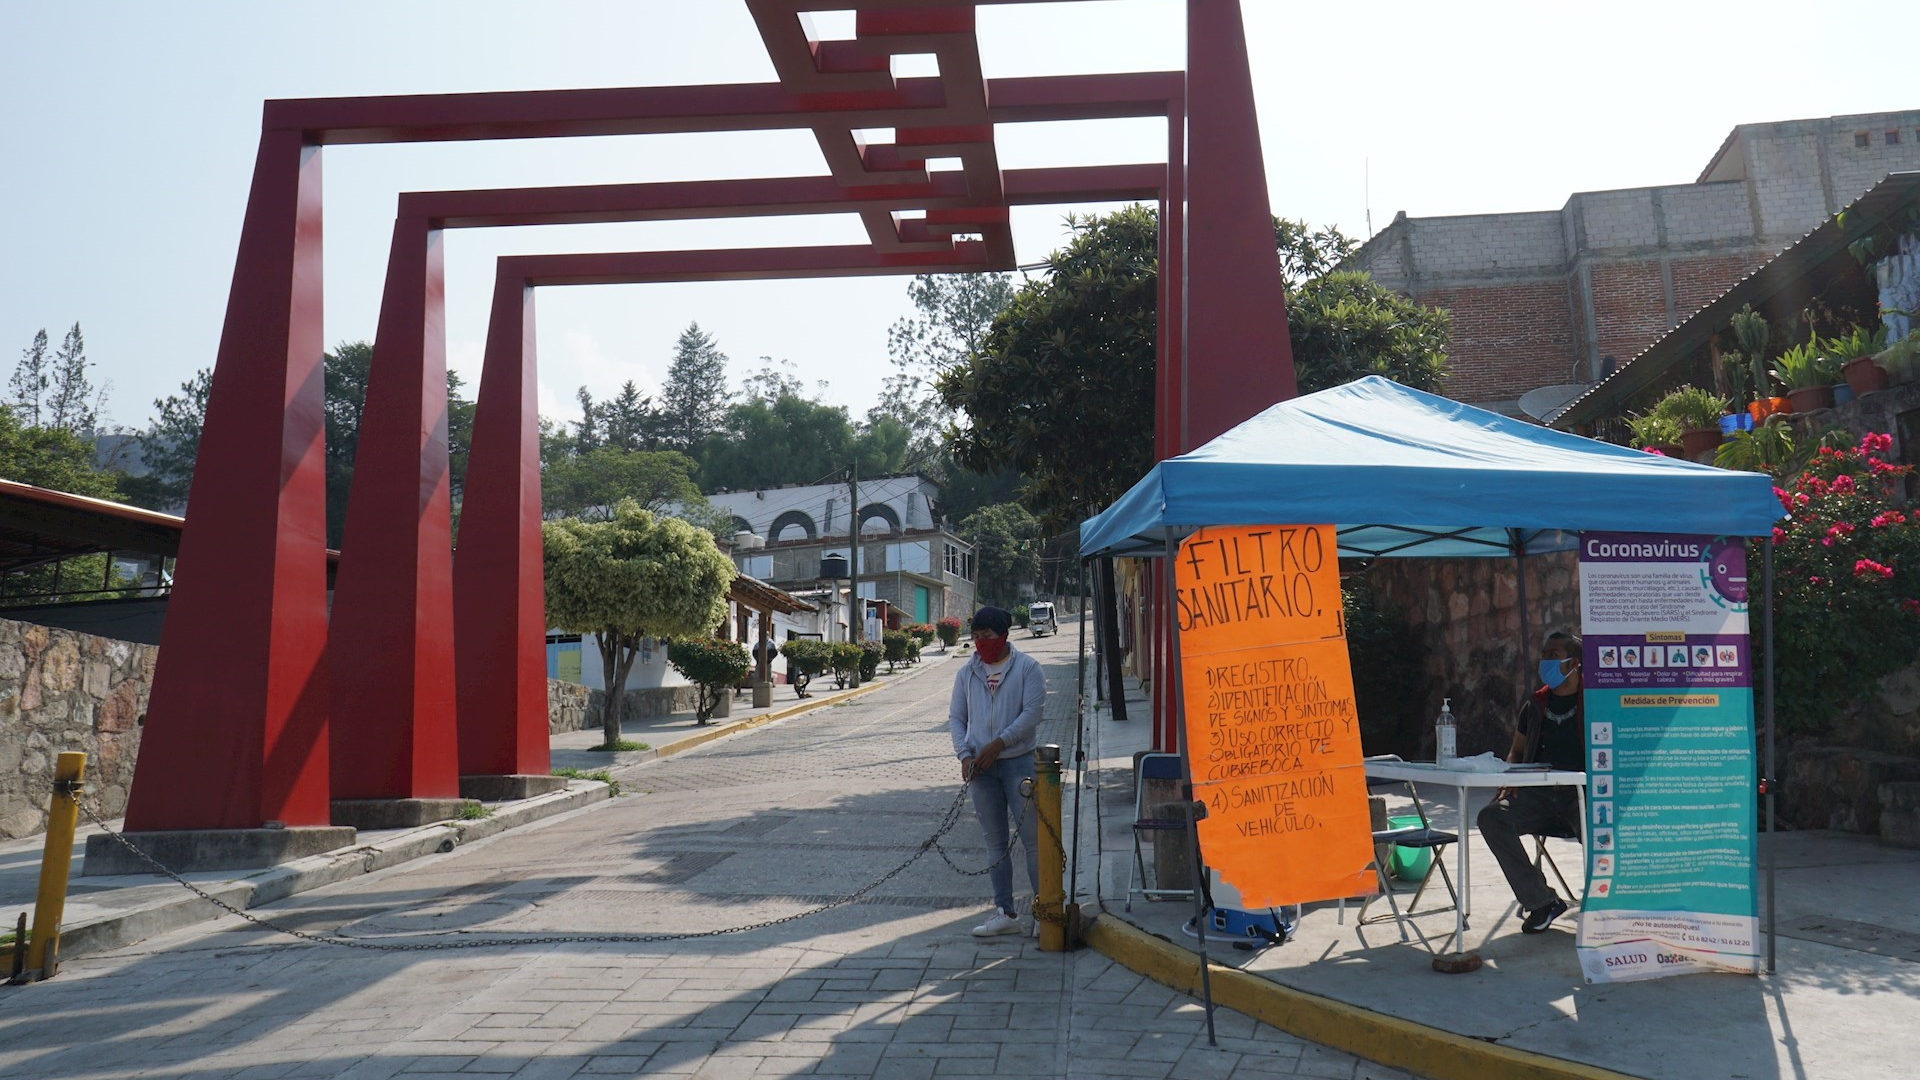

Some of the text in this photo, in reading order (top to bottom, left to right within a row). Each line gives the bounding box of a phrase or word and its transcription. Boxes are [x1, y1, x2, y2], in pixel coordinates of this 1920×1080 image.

[1186, 527, 1323, 580] FILTRO
[1587, 539, 1699, 558] Coronavirus
[1650, 633, 1682, 641] Síntomas
[1209, 697, 1355, 728] DE SIGNOS Y SINTOMAS
[1624, 697, 1655, 705] Medidas
[1668, 696, 1715, 704] Prevención
[1261, 718, 1334, 742] CORRECTO
[1342, 717, 1353, 733] Y
[1209, 737, 1334, 762] OBLIGATORIO DE
[1208, 757, 1304, 781] CUBREBOCA
[1231, 771, 1335, 809] SANITIZACIÓN
[1275, 802, 1297, 817] DE
[1605, 953, 1647, 967] SALUD
